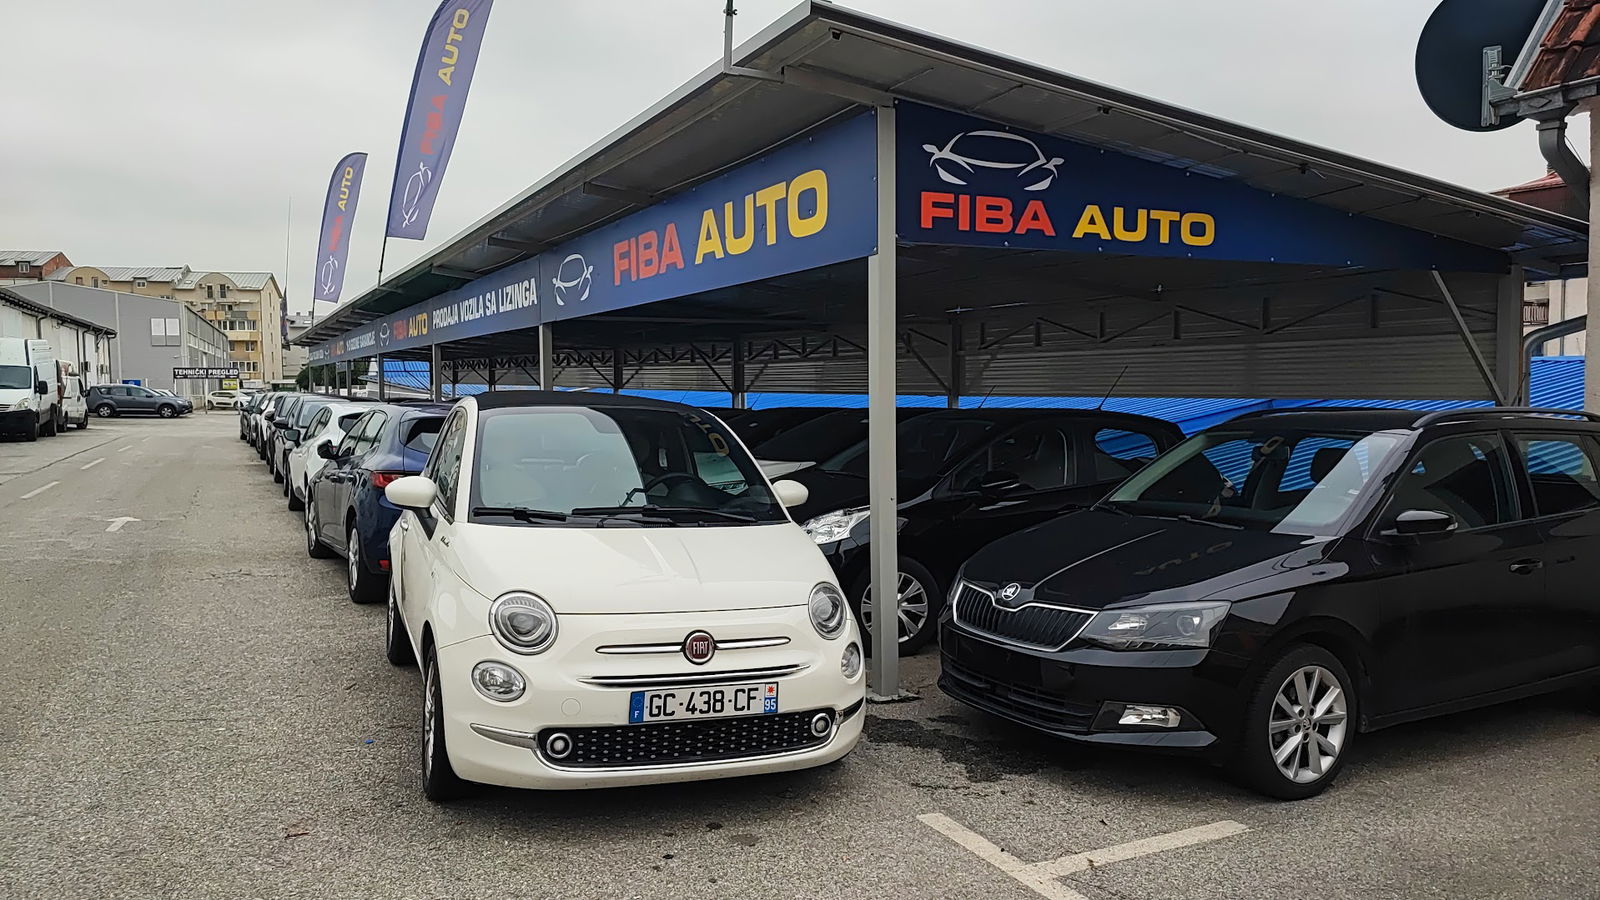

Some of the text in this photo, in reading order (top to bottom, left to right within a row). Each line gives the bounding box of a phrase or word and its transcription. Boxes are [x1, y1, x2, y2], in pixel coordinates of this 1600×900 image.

[437, 8, 471, 86] AUTO
[337, 166, 353, 212] AUTO
[613, 169, 829, 287] FIBA AUTO
[920, 191, 1216, 247] FIBA AUTO
[408, 312, 428, 338] AUTO
[432, 277, 538, 330] PRODAJA VOZILA SA LIZINGA
[692, 641, 709, 655] FIAT
[634, 710, 639, 719] F
[764, 698, 777, 712] 95
